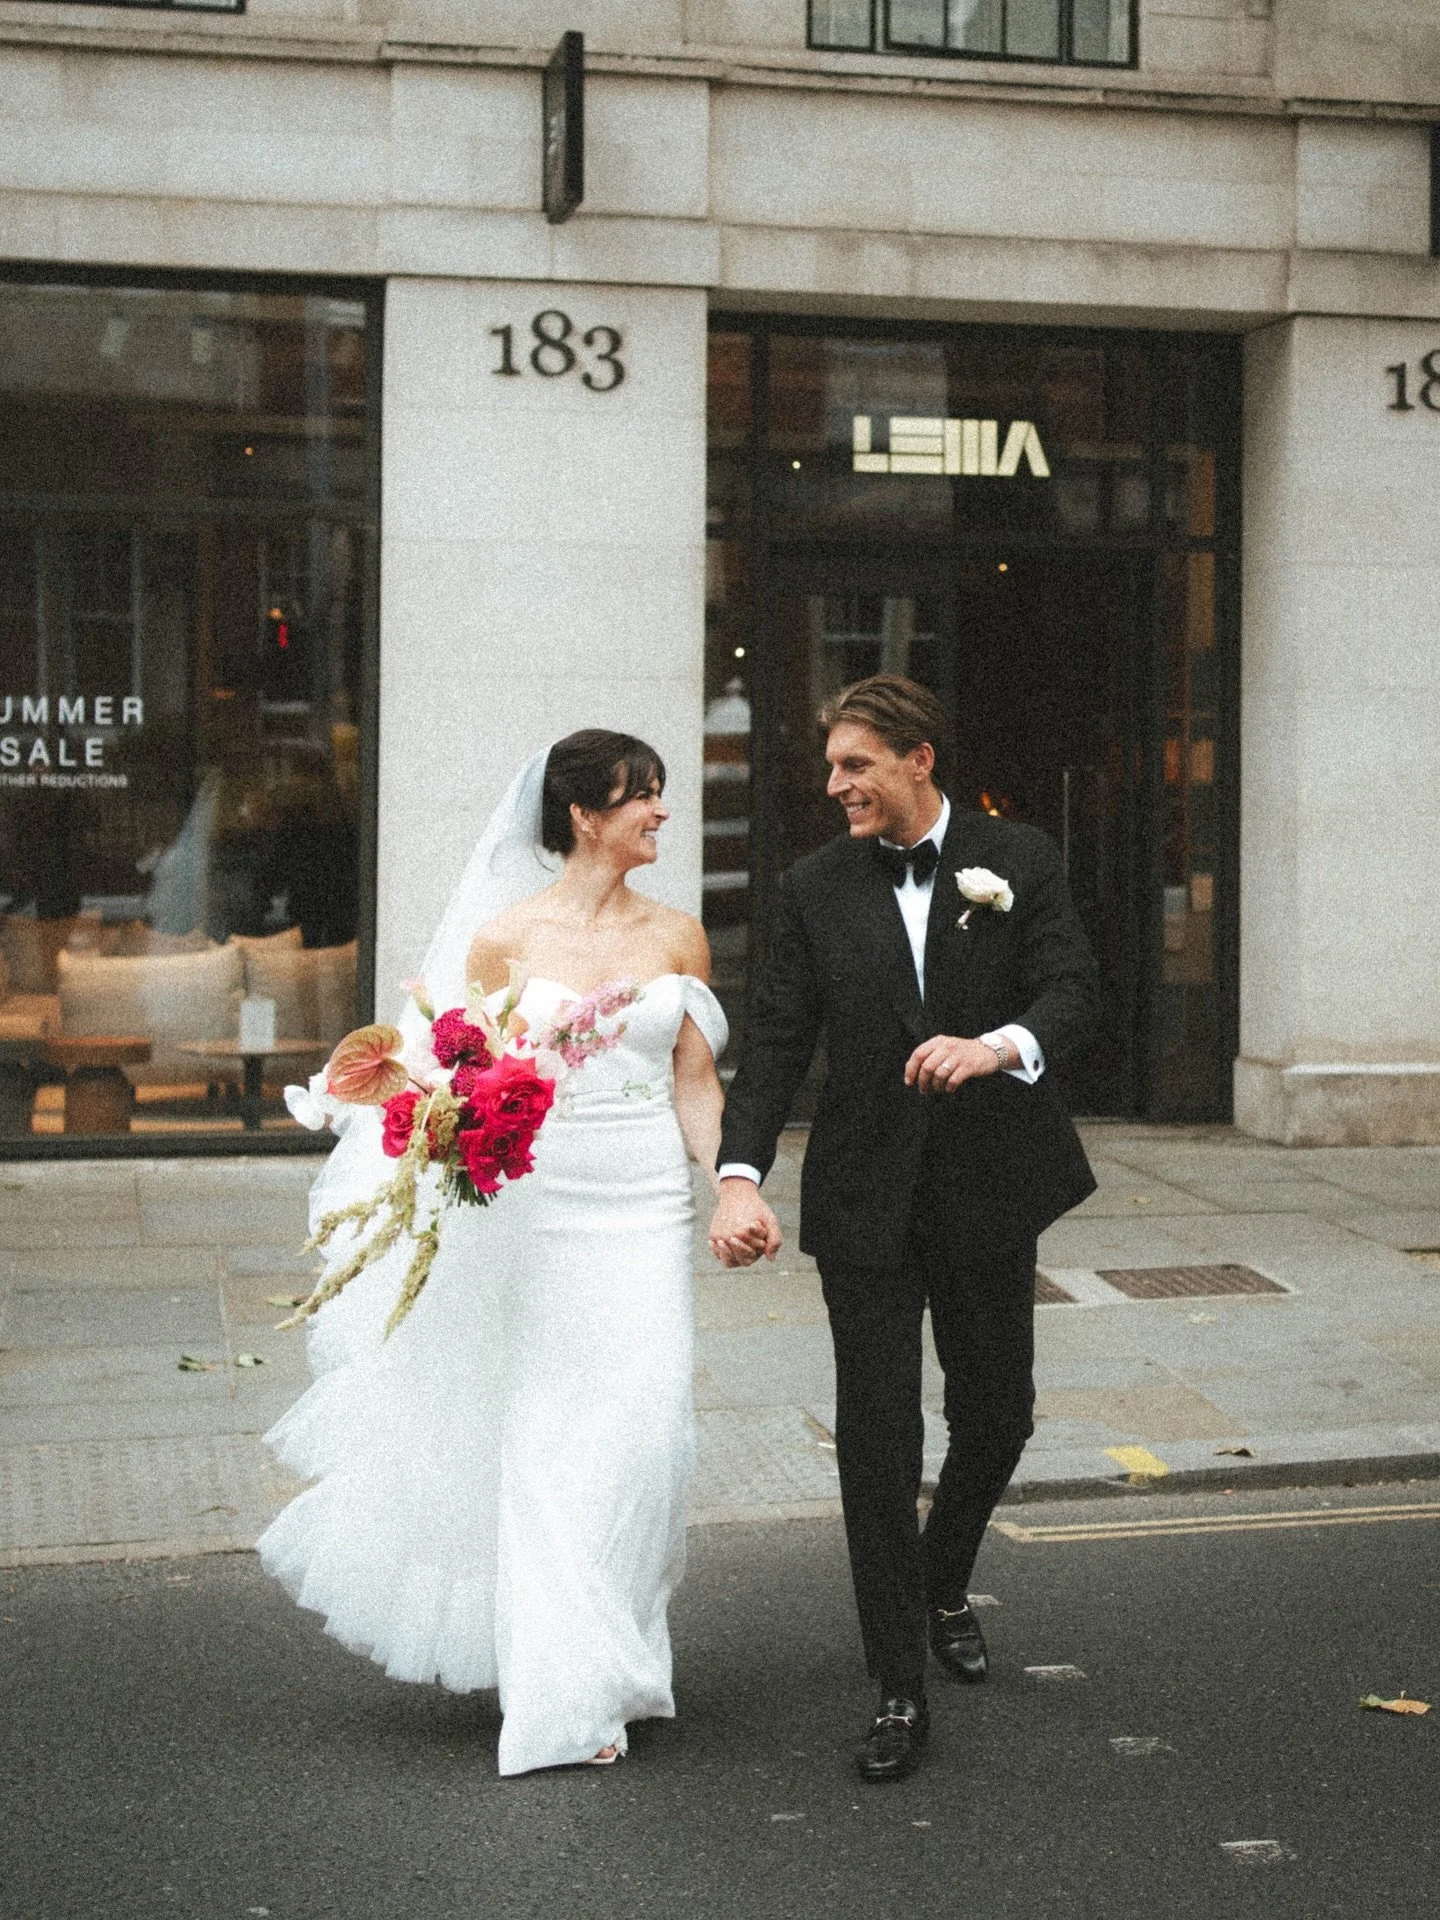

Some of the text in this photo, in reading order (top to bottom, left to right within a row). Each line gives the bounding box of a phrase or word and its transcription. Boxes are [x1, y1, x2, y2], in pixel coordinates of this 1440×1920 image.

[491, 309, 626, 392] 183
[0, 736, 104, 767] SALE
[40, 773, 129, 789] REDUCTIONS
